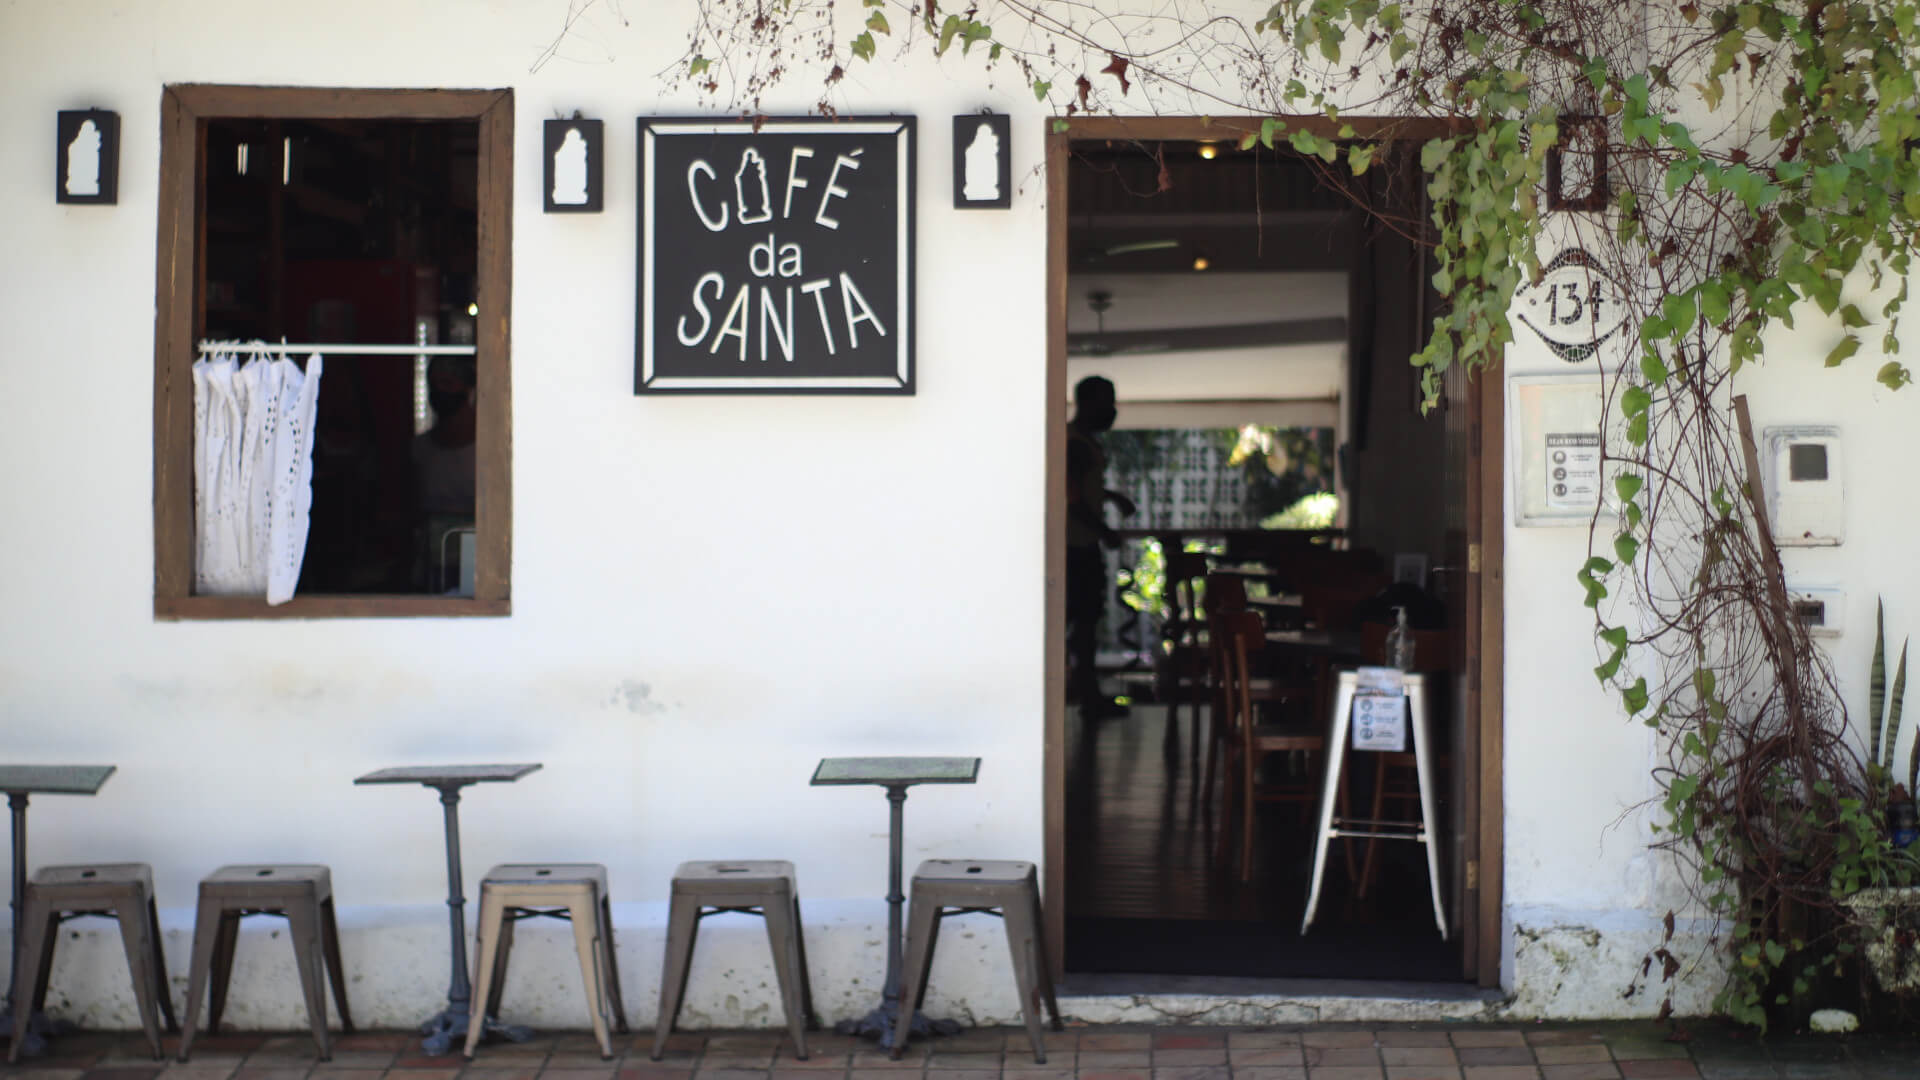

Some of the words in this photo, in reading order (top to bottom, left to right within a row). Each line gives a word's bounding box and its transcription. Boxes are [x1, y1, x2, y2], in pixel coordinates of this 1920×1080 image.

[749, 233, 802, 278] da
[677, 271, 887, 362] SANTA
[1545, 281, 1605, 326] 134
